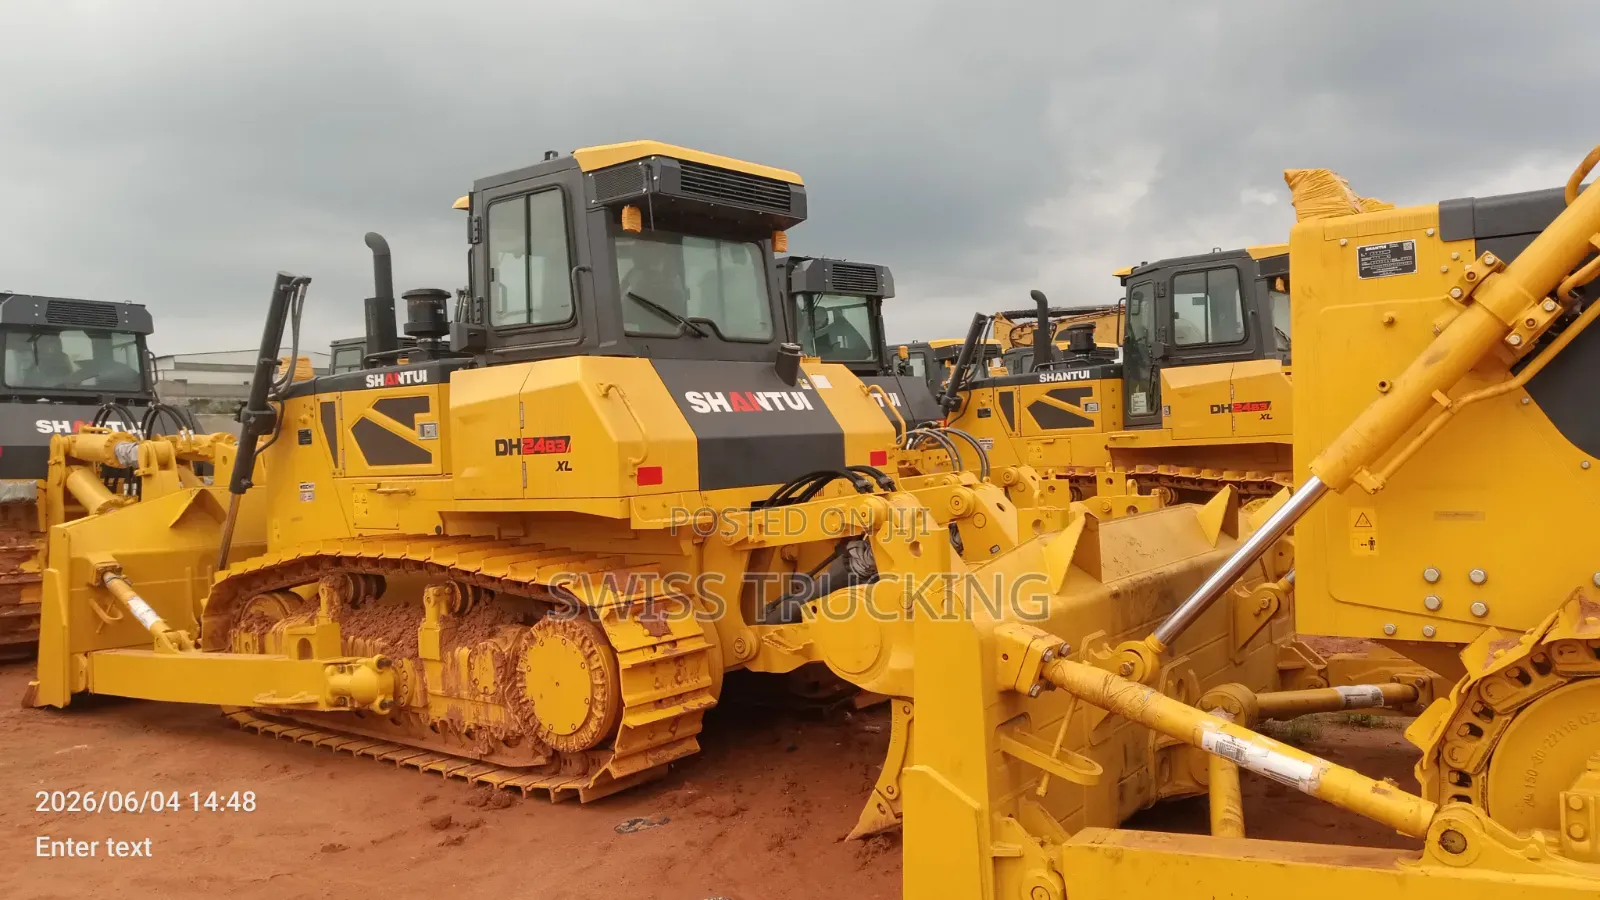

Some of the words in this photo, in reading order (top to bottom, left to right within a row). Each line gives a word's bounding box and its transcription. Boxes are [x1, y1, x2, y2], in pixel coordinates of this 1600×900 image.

[365, 369, 428, 388] SHANTUI
[1039, 370, 1090, 383] SHANTUI
[684, 391, 814, 414] SHANTUI
[556, 460, 573, 471] XL
